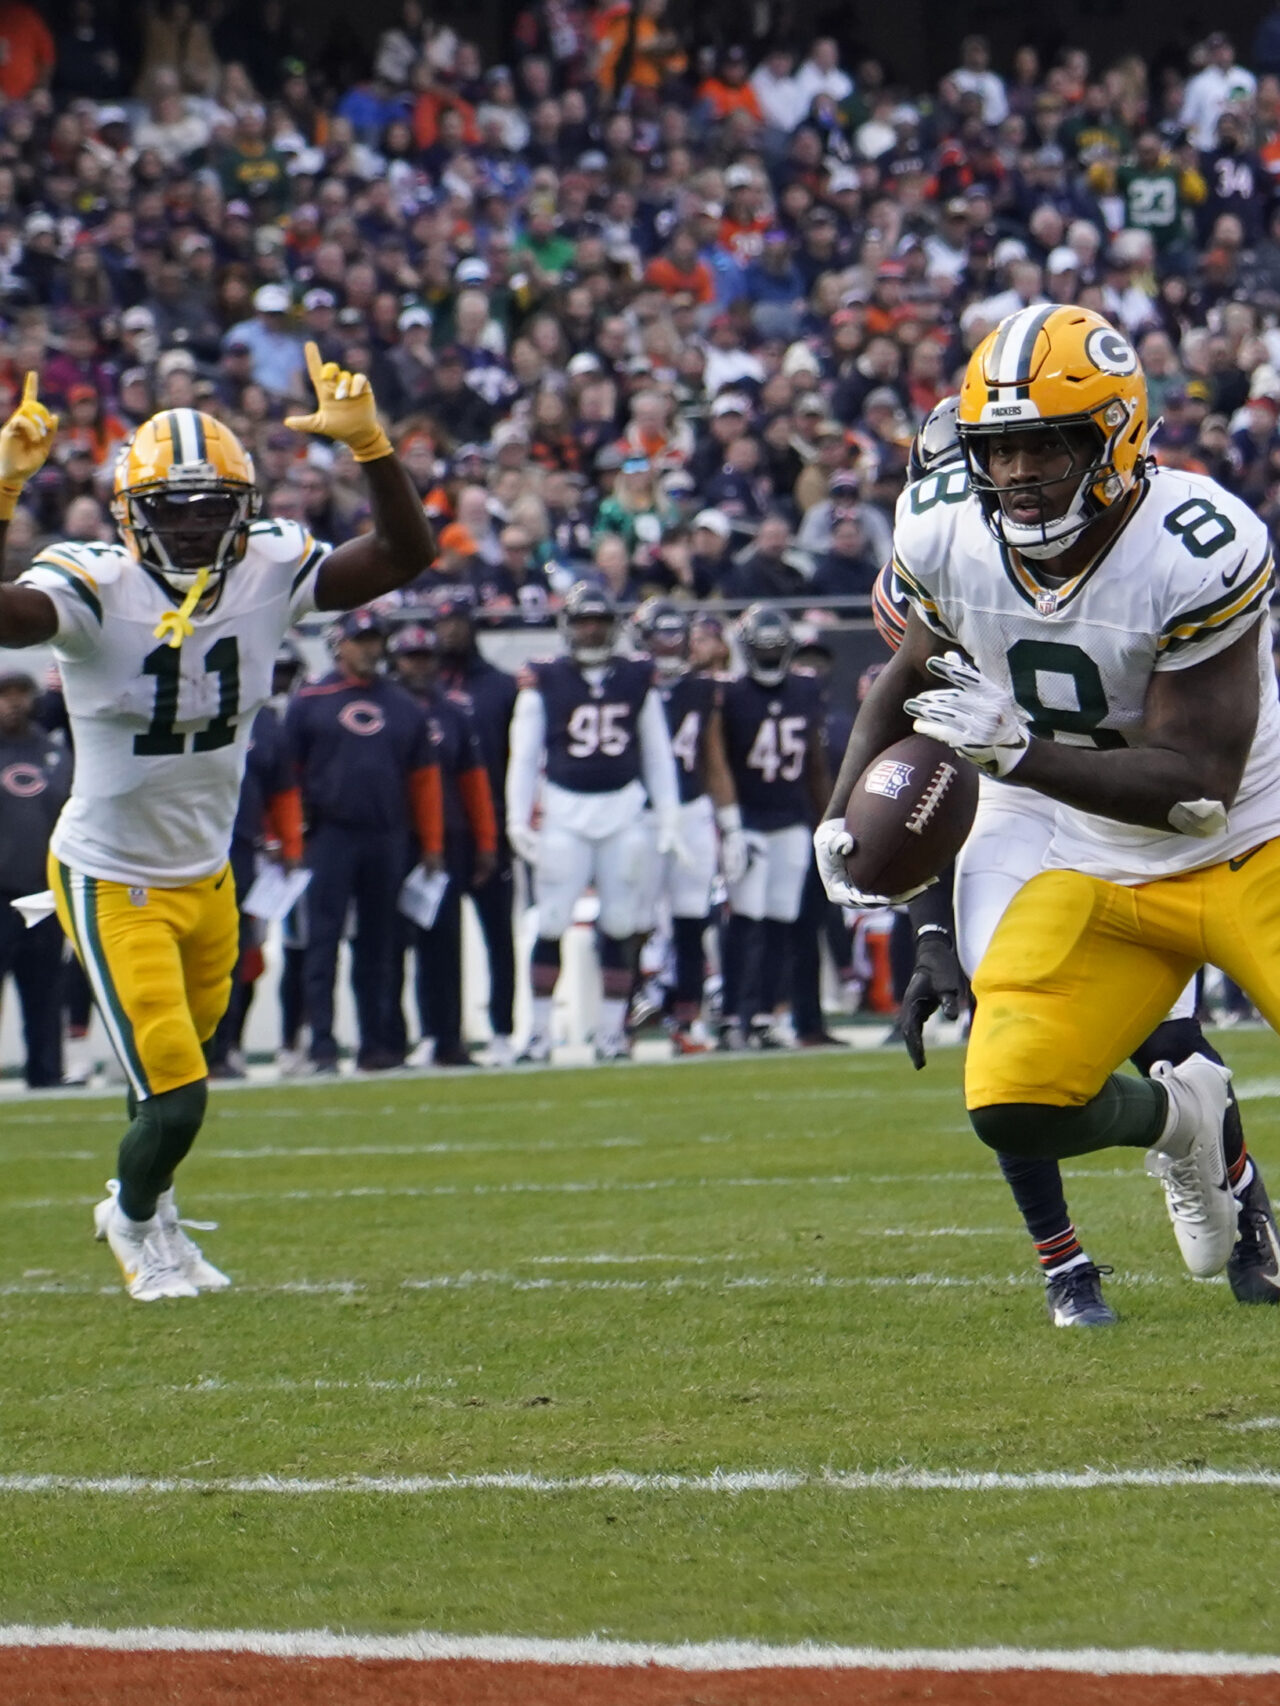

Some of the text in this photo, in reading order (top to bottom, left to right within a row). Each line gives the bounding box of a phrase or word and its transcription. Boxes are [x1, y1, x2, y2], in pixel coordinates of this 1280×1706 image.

[1127, 178, 1177, 227] 23
[1214, 157, 1254, 200] 34
[991, 406, 1022, 418] PACKERS
[911, 468, 971, 515] 8
[1163, 498, 1236, 559] 8
[133, 636, 239, 756] 11
[1006, 639, 1130, 749] 8
[567, 703, 631, 758] 95
[671, 711, 702, 773] 4
[746, 716, 807, 783] 45
